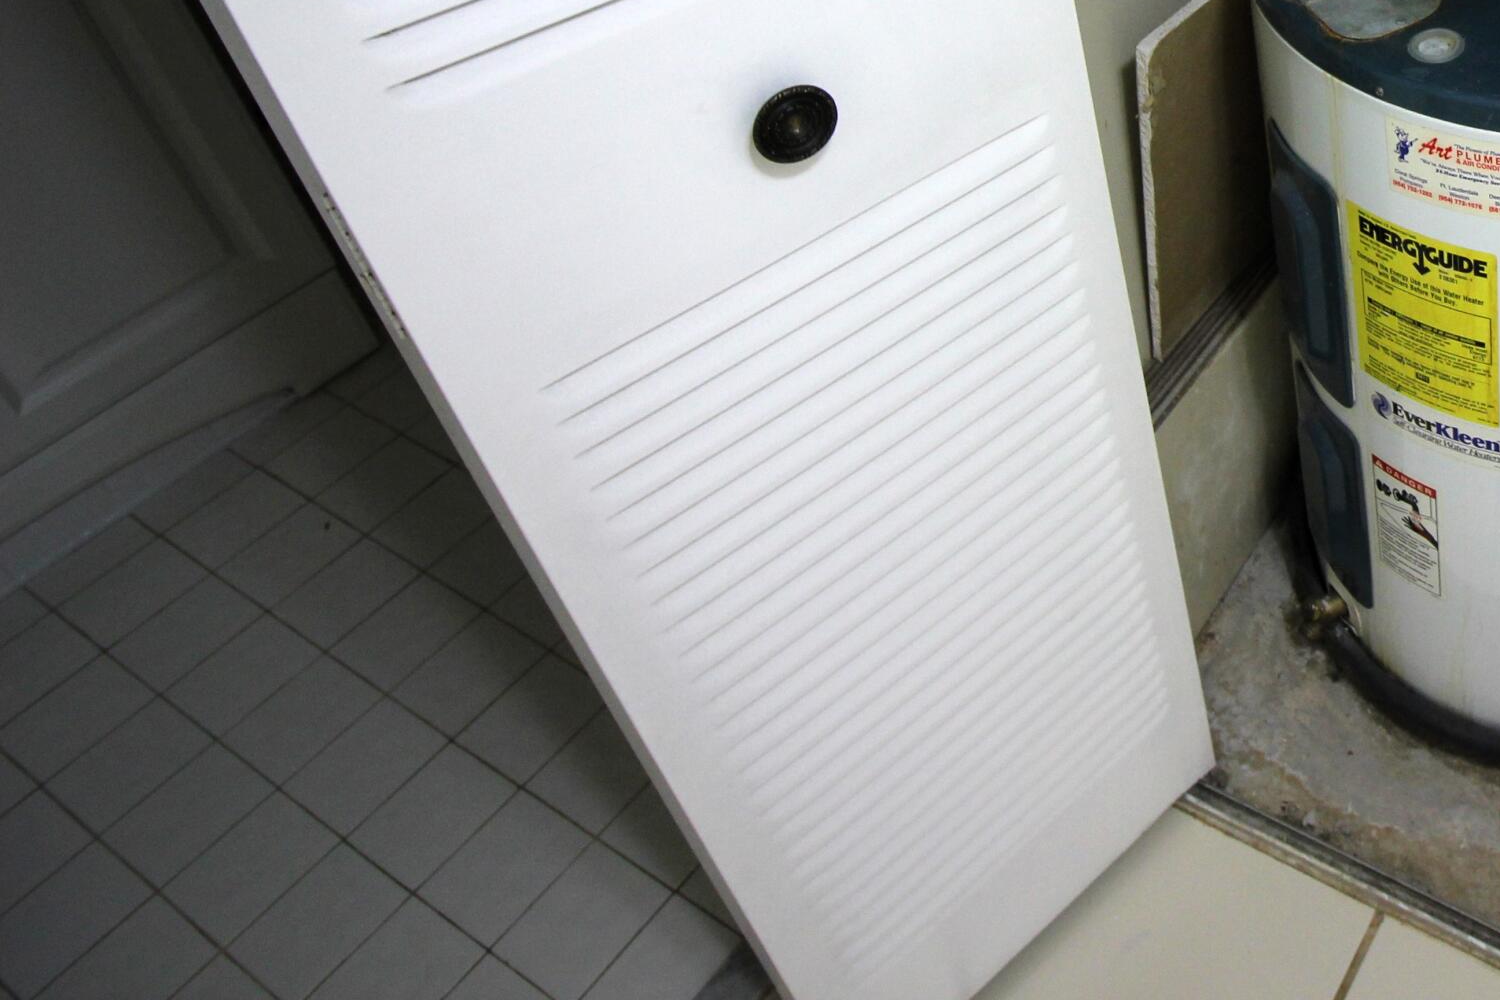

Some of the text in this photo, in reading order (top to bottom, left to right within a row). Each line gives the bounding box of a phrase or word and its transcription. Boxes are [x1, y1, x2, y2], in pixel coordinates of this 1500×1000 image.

[1418, 137, 1453, 161] Art
[1463, 160, 1475, 168] AIR
[1358, 214, 1488, 278] ENERGYGUIDE
[1391, 400, 1500, 453] EverKleen
[1386, 466, 1433, 498] DANGER
